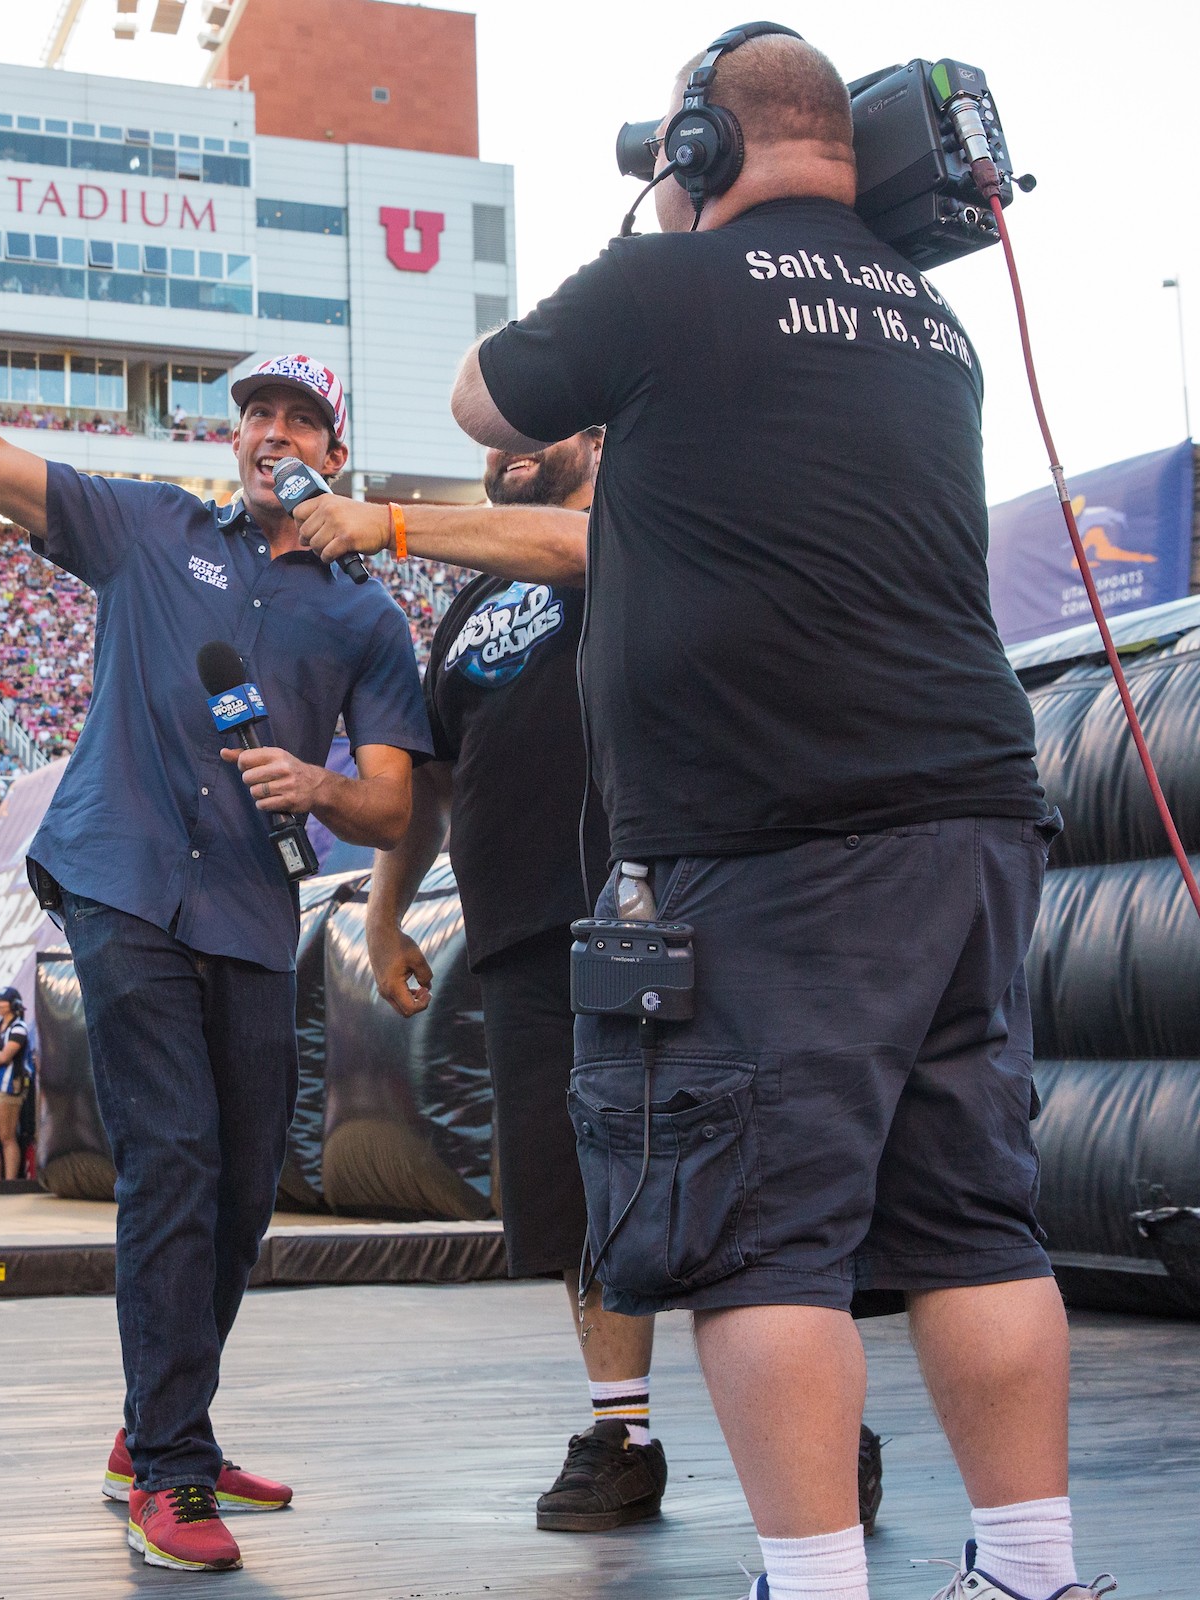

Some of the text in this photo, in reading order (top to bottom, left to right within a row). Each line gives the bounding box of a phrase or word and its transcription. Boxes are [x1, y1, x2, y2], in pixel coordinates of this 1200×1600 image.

[379, 206, 445, 273] U
[745, 250, 917, 298] Salt Lake
[778, 298, 858, 341] July
[872, 306, 920, 349] 16,
[188, 561, 228, 583] WORLD
[190, 554, 226, 573] NITRO
[193, 572, 229, 590] GAMES
[1062, 586, 1086, 602] UTA
[447, 584, 550, 663] WORLD
[481, 603, 562, 663] GAMES
